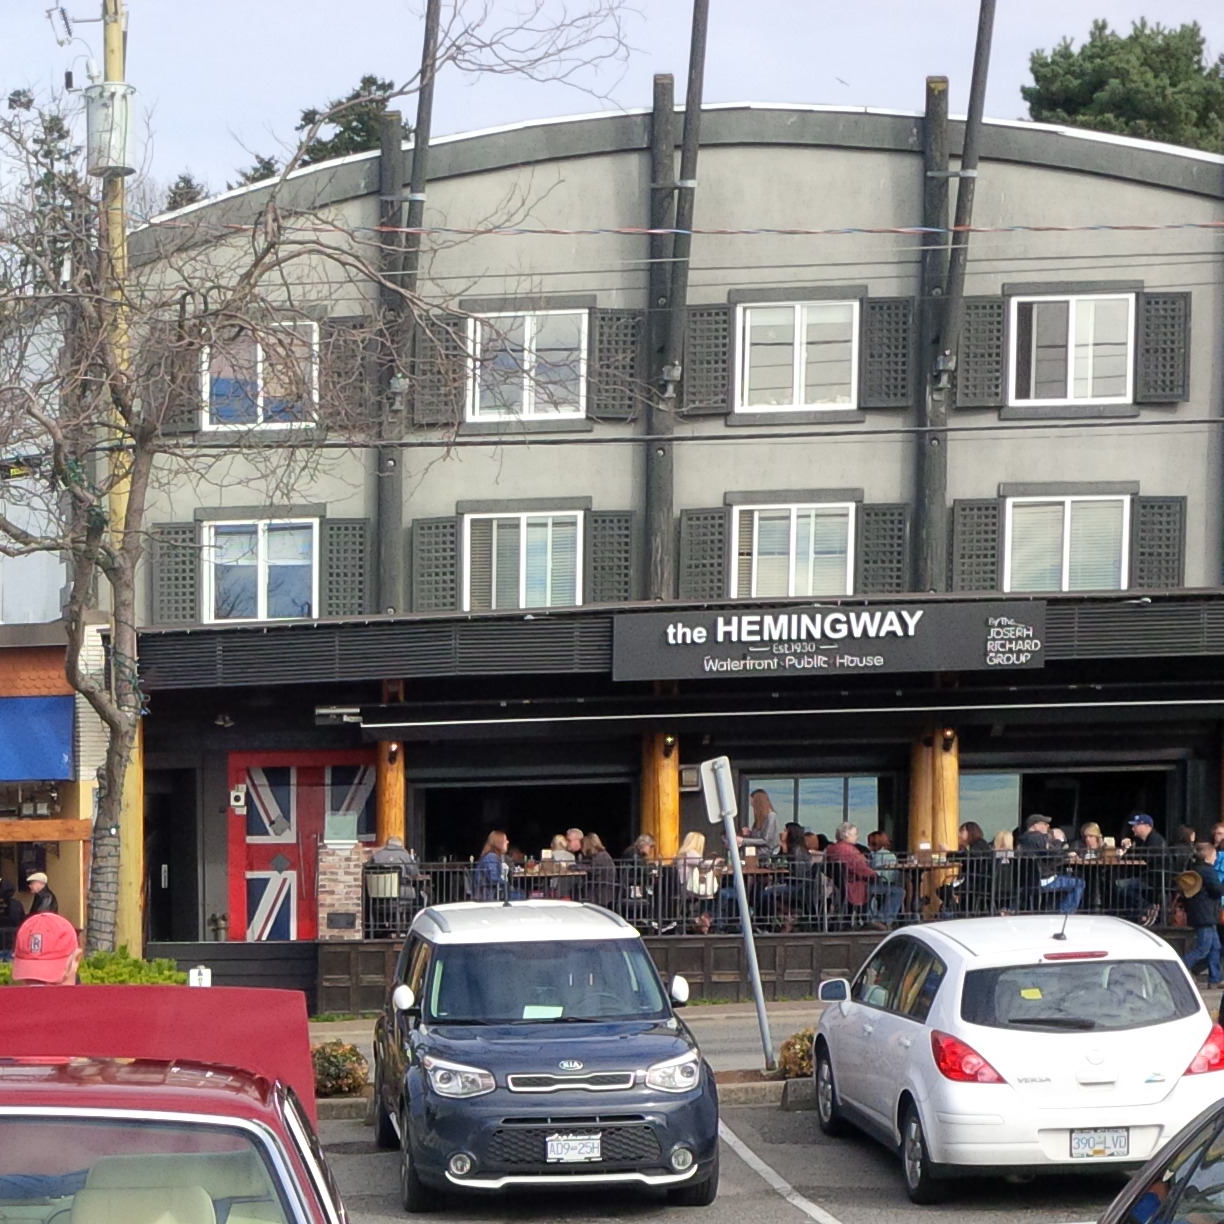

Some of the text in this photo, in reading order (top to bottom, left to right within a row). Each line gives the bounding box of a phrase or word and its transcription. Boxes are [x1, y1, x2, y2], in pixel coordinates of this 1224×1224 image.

[666, 610, 924, 644] the HEMINGWAY
[987, 640, 1041, 652] RICHARD
[704, 654, 884, 672] Waterfront Public House
[987, 653, 1031, 665] GROUP
[1017, 1076, 1052, 1084] VERSA
[549, 1142, 600, 1156] AD9 25H
[1073, 1136, 1127, 1150] 390 LVD
